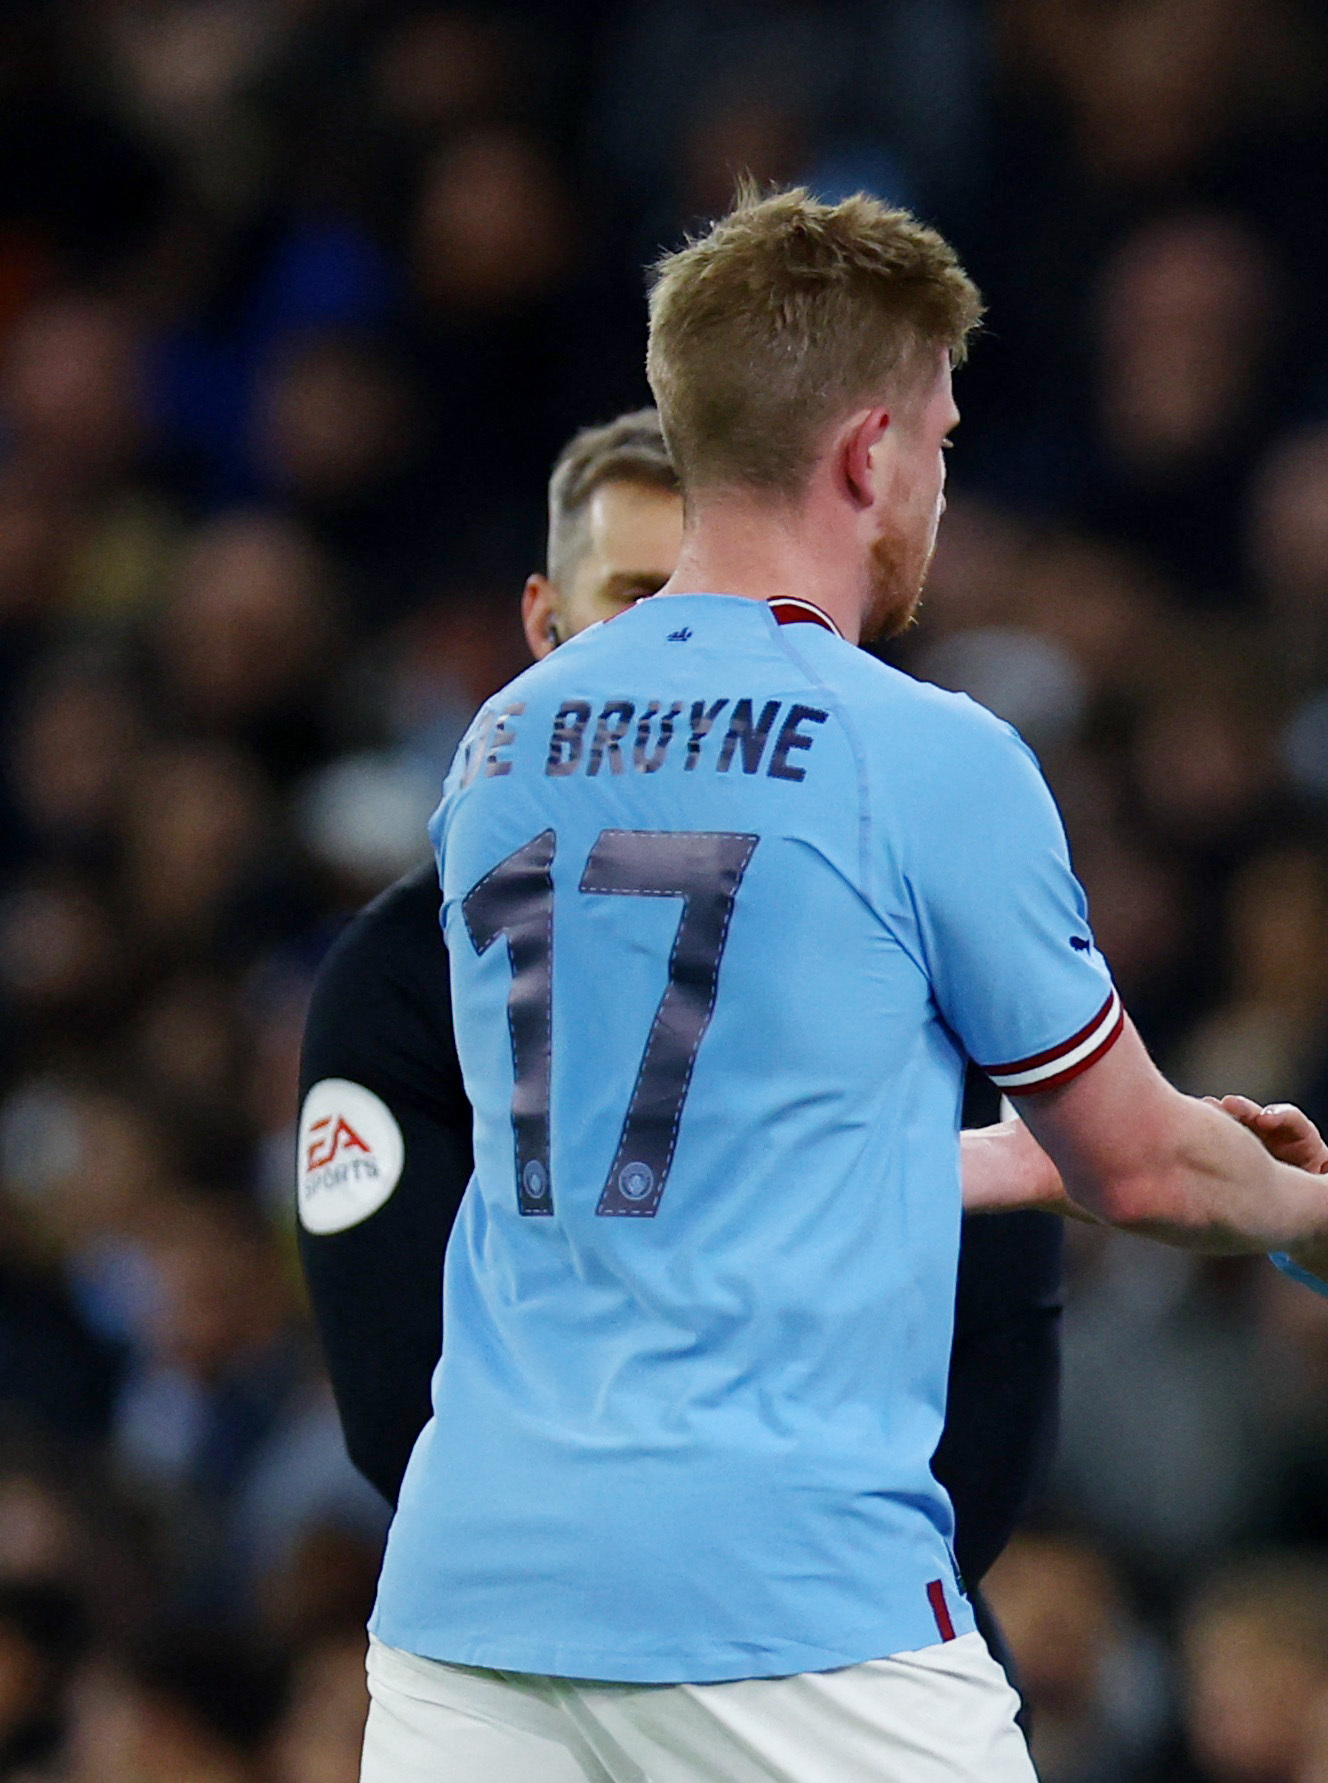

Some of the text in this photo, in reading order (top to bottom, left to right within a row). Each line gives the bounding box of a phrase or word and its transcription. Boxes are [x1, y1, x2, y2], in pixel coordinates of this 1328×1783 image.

[545, 699, 829, 782] BRUYNE
[463, 828, 760, 1218] 17
[307, 1114, 371, 1173] EA
